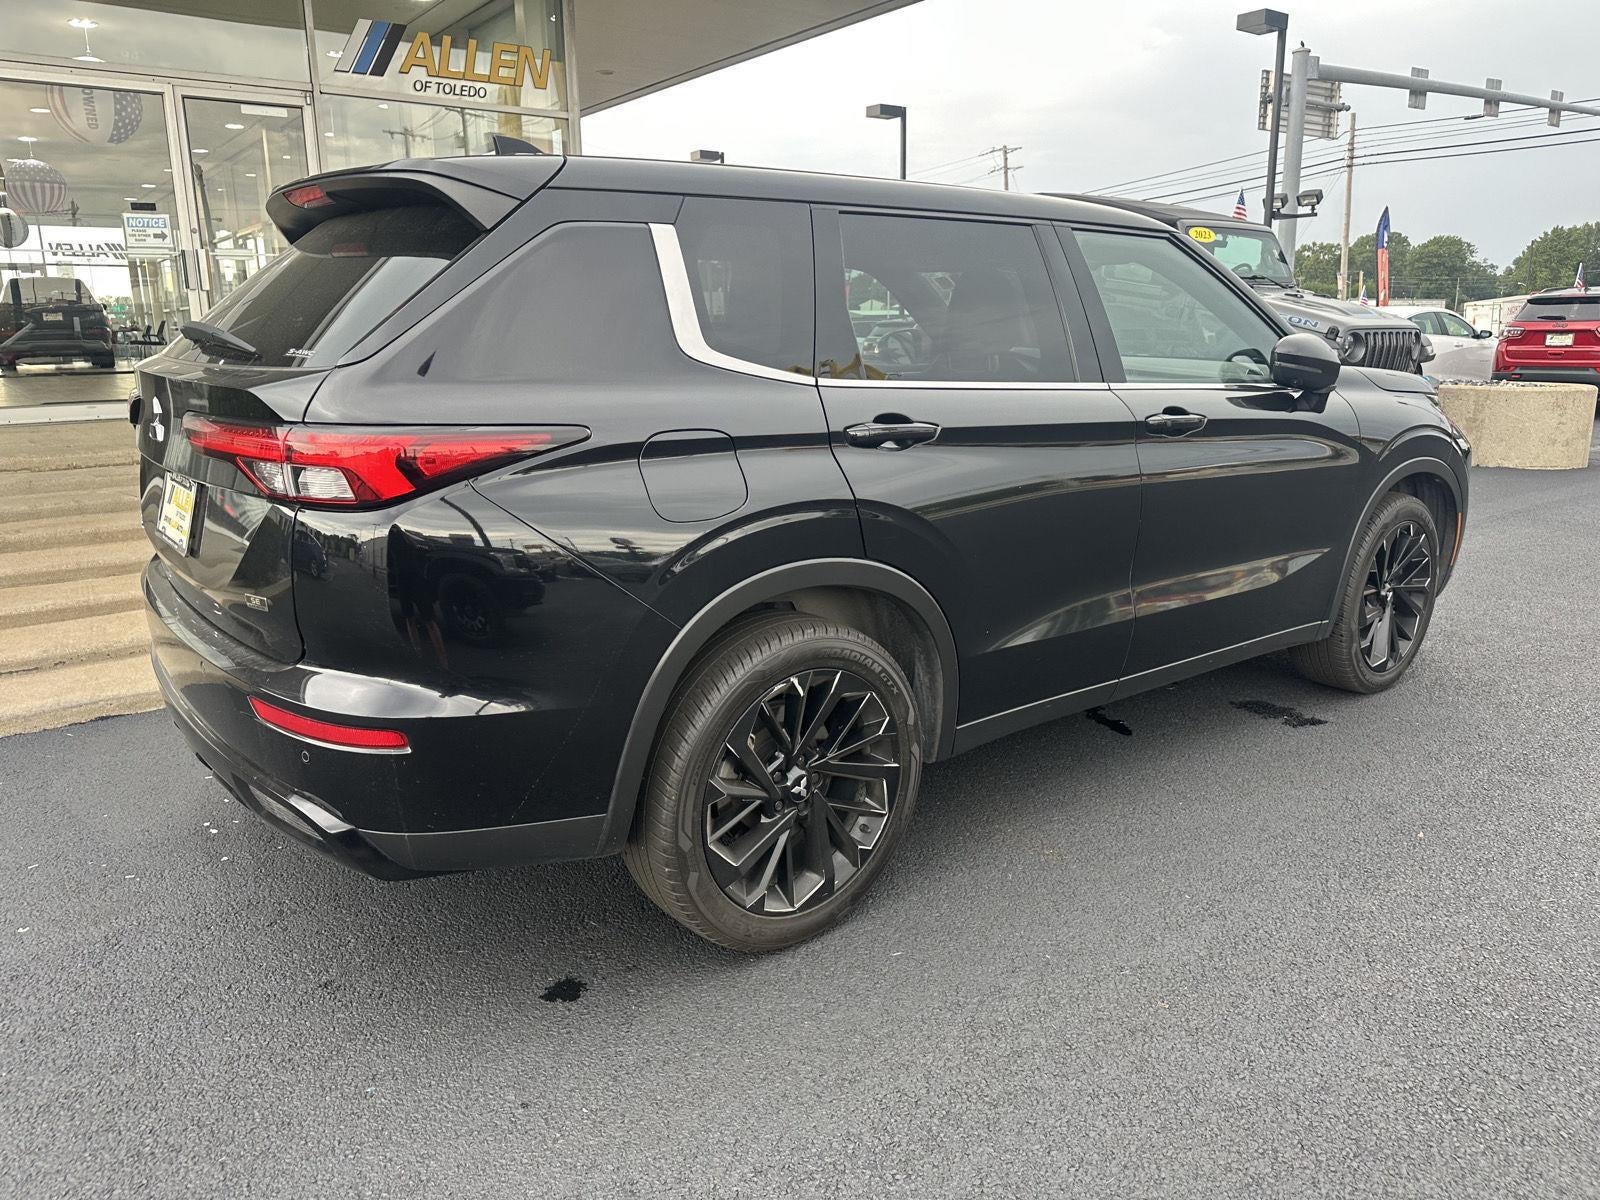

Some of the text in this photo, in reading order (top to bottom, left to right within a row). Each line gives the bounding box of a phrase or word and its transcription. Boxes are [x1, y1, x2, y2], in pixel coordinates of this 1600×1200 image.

[399, 31, 551, 90] ALLEN
[413, 79, 487, 98] OF TOLEDO
[81, 88, 99, 130] OWNED
[129, 217, 166, 227] NOTICE
[1194, 229, 1212, 240] 2023
[1287, 316, 1319, 328] ON
